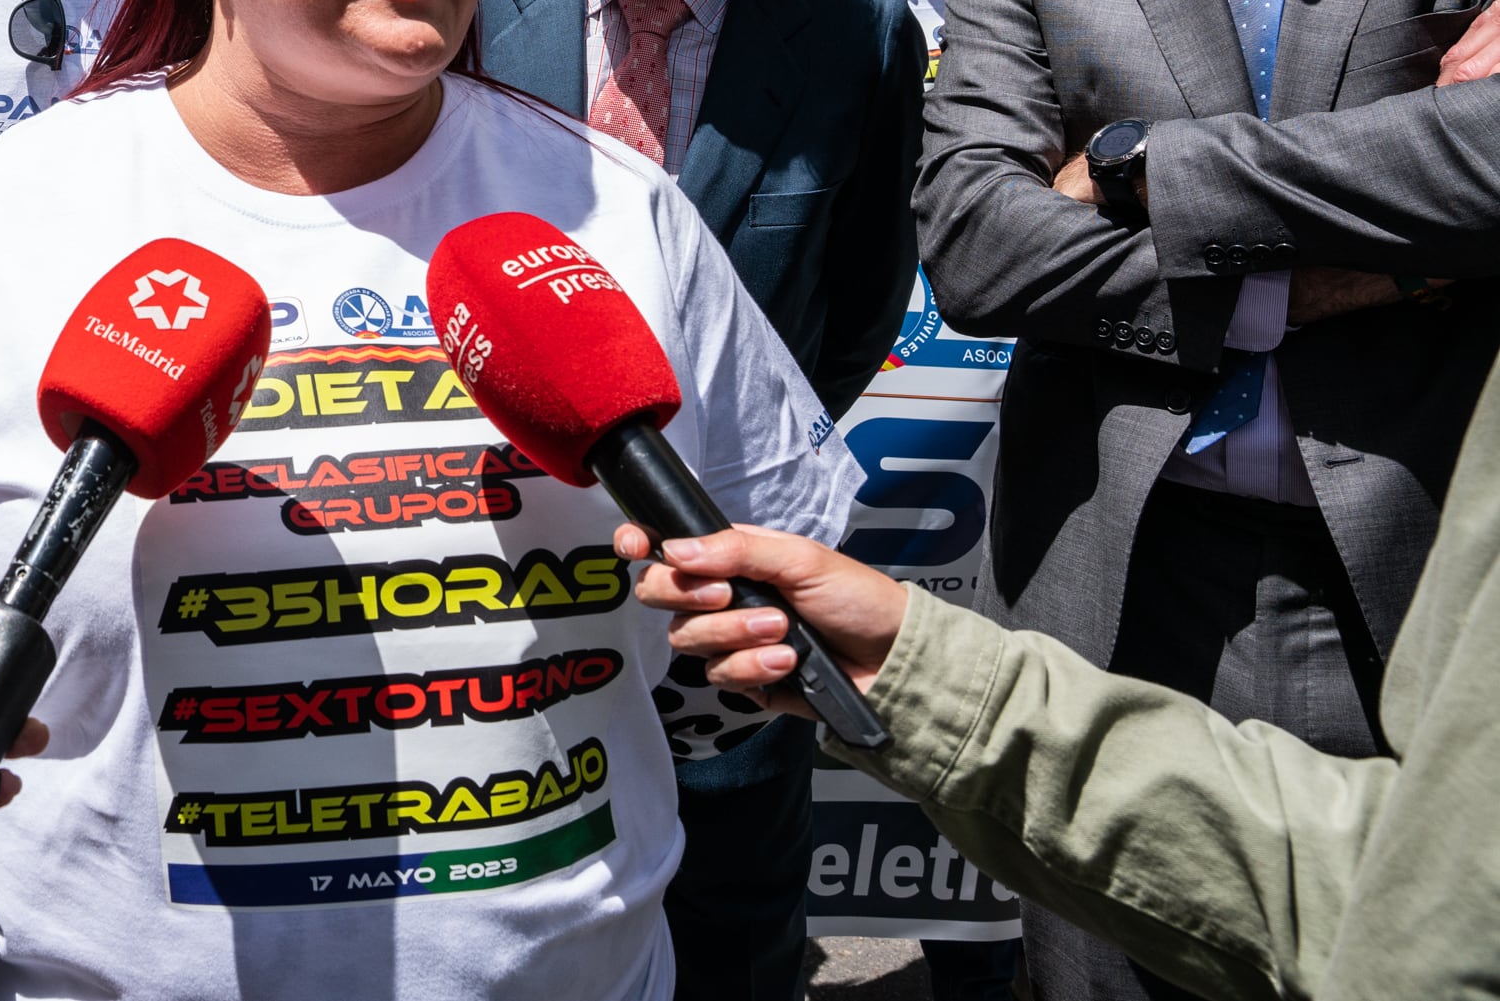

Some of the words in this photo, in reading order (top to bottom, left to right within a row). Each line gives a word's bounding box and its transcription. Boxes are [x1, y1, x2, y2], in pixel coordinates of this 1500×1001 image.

[84, 315, 187, 381] TeleMadrid
[443, 302, 472, 354] opa
[900, 310, 939, 358] CIVILES
[962, 348, 1012, 364] ASOCI
[241, 369, 481, 420] DIETA
[289, 486, 514, 528] GRUPOB
[177, 557, 621, 633] #35HORAS
[173, 656, 615, 733] #SEXTOTURNO
[177, 746, 605, 837] #TELETRABAJO
[310, 875, 334, 892] 17
[347, 866, 437, 889] MAYO
[448, 857, 519, 881] 2023
